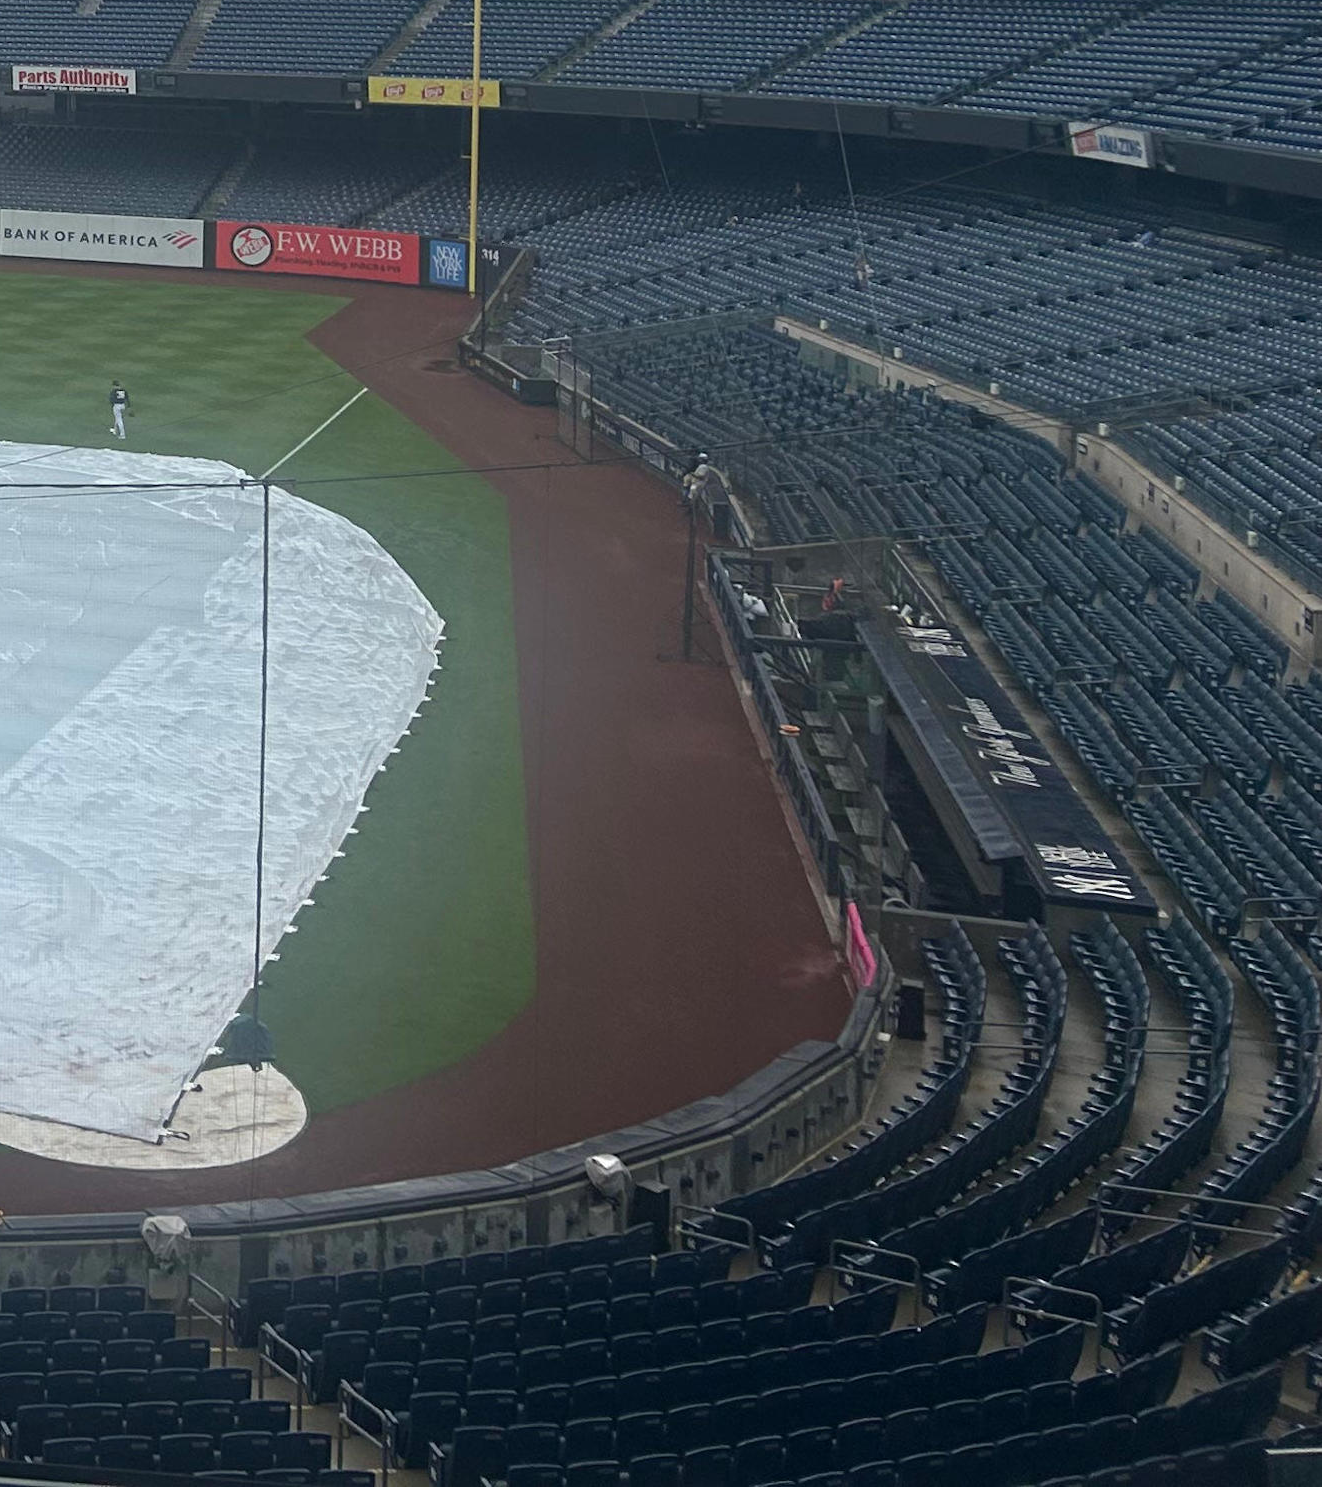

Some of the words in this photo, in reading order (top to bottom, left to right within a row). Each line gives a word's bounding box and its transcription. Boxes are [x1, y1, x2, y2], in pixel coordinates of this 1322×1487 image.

[19, 71, 56, 83] Parts
[60, 69, 128, 86] Authority
[3, 228, 49, 242] BANK
[54, 230, 77, 244] OF
[81, 231, 158, 248] AMERICA
[277, 230, 321, 254] F.W.
[329, 234, 402, 260] WEBB
[436, 245, 460, 258] NEW
[481, 249, 499, 261] 314
[432, 256, 462, 271] YORK
[436, 269, 459, 281] LIFE
